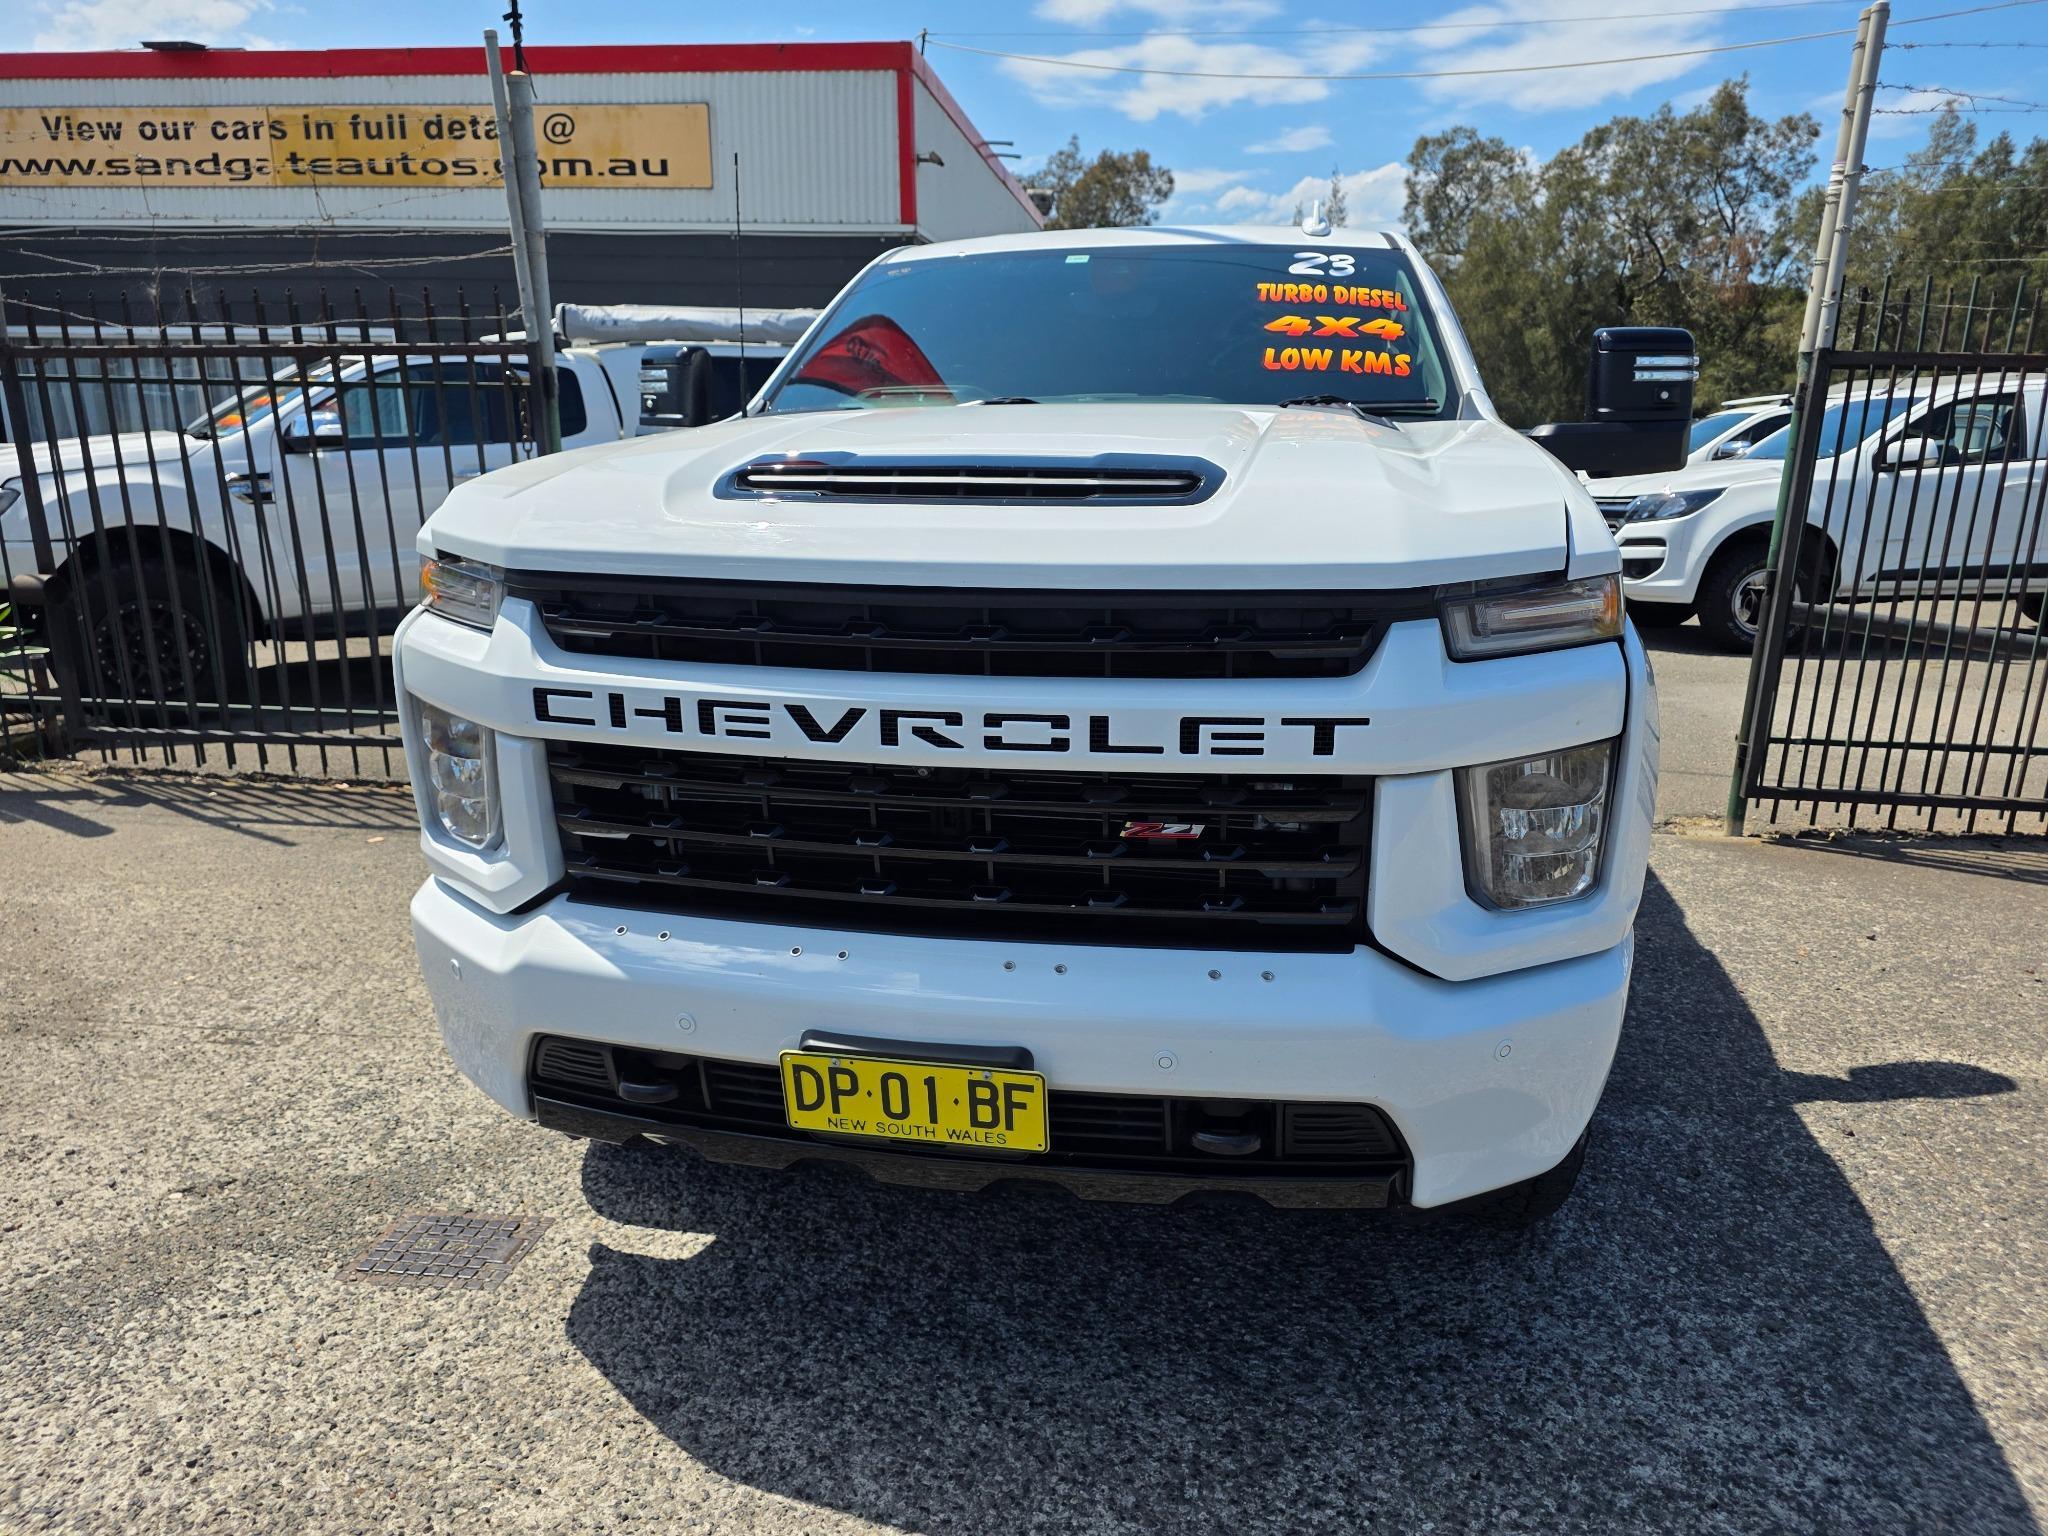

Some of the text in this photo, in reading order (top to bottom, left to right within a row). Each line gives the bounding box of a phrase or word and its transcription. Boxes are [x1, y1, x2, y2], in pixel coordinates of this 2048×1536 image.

[41, 115, 123, 141] View
[138, 120, 196, 141] our
[210, 119, 288, 141] cars
[303, 113, 334, 140] in
[348, 113, 408, 140] full
[543, 112, 575, 145] @
[1287, 252, 1356, 277] 23
[1256, 283, 1408, 312] TURBO DIESEL
[1263, 347, 1412, 377] LOW KMS
[532, 686, 1371, 756] CHEVROLET
[1120, 821, 1206, 839] Z71
[827, 1116, 1008, 1146] NEW SOUTH WALES
